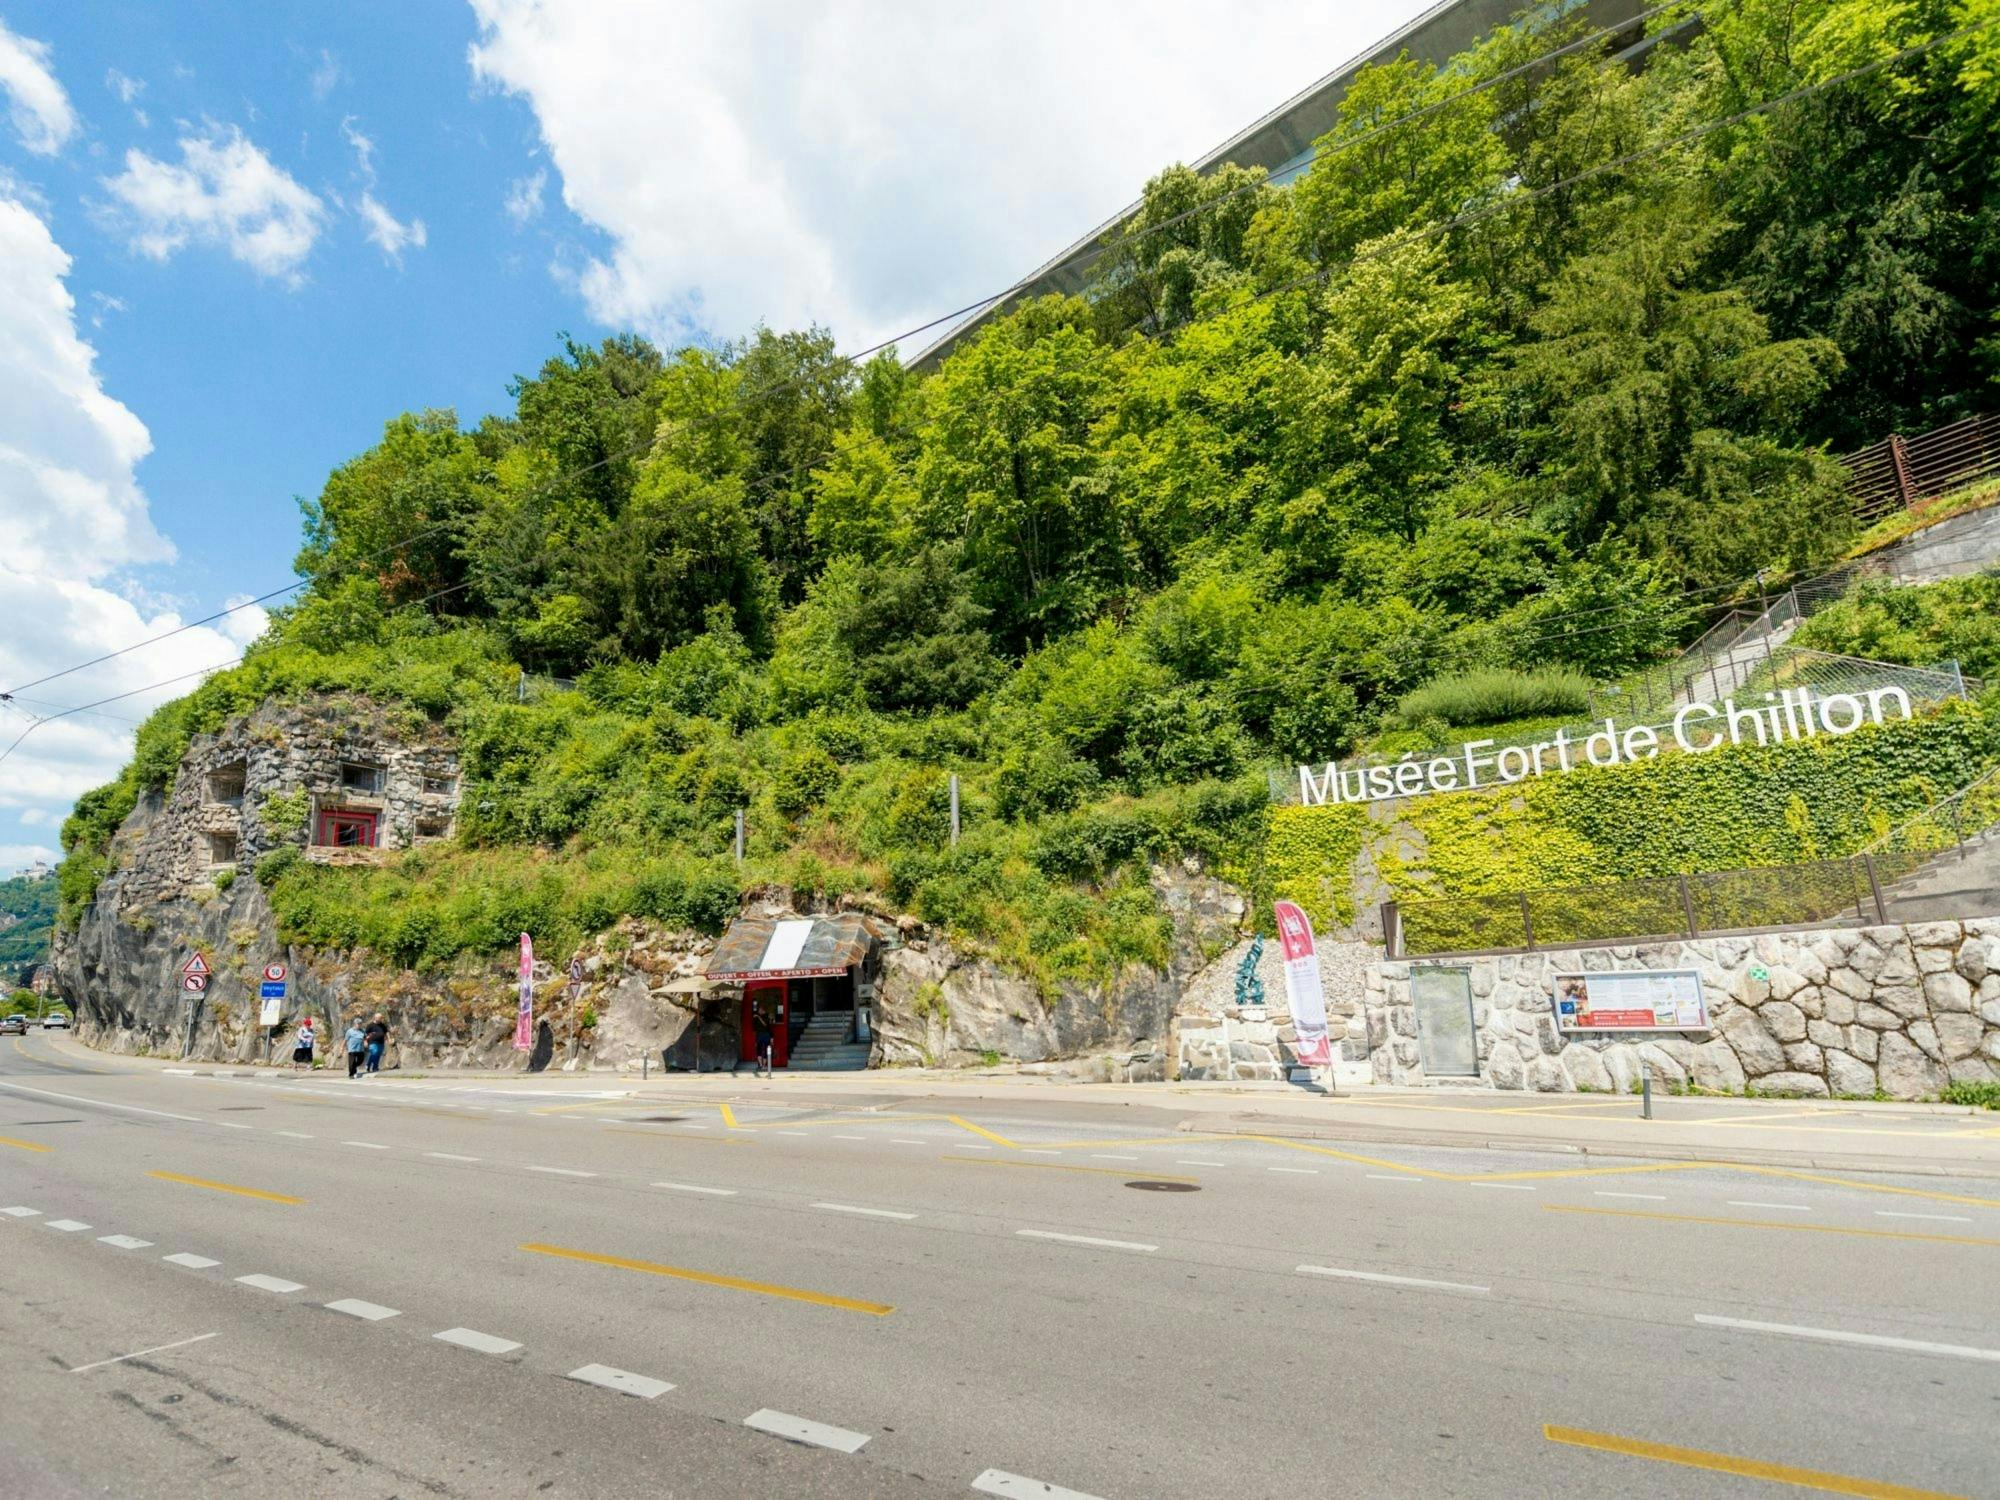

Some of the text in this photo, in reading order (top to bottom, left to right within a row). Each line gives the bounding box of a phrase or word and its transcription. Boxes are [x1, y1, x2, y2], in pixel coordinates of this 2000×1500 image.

[1299, 685, 1913, 806] Musée Fort de Chillon
[707, 972, 737, 980] OUVERT
[780, 969, 812, 977] APERTO
